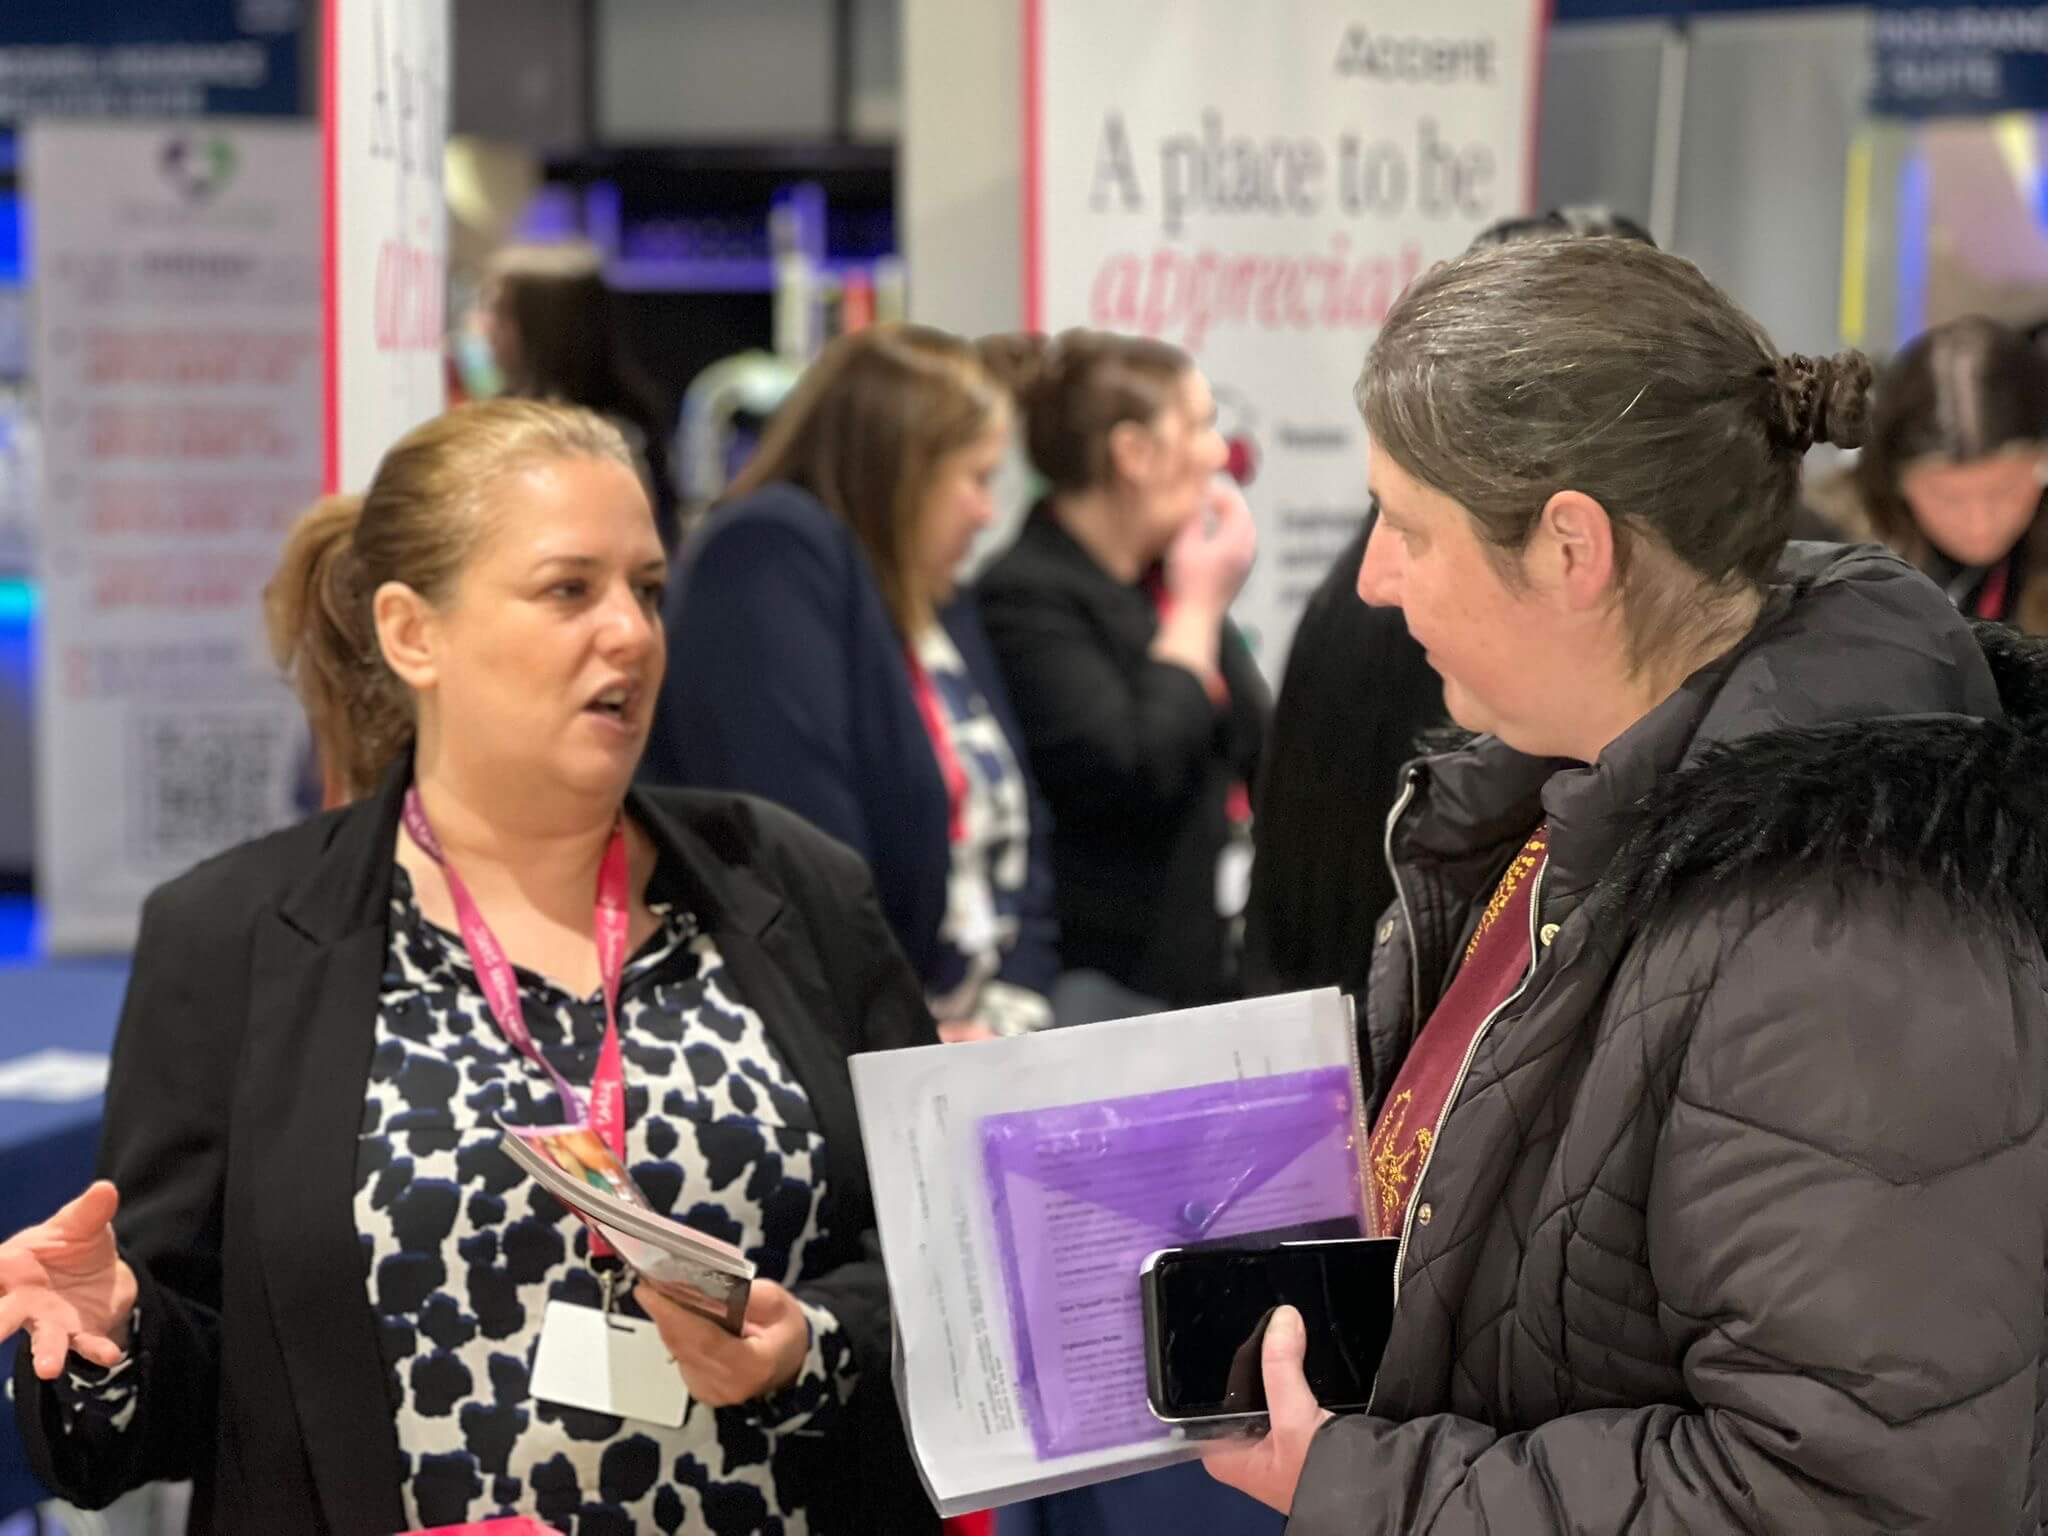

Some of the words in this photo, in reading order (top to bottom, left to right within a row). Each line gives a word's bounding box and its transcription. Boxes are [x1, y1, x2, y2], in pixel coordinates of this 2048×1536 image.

[1334, 24, 1497, 83] Accent
[1089, 107, 1143, 214] A
[1160, 106, 1325, 238] place
[1338, 132, 1409, 219] to
[1416, 115, 1497, 221] be
